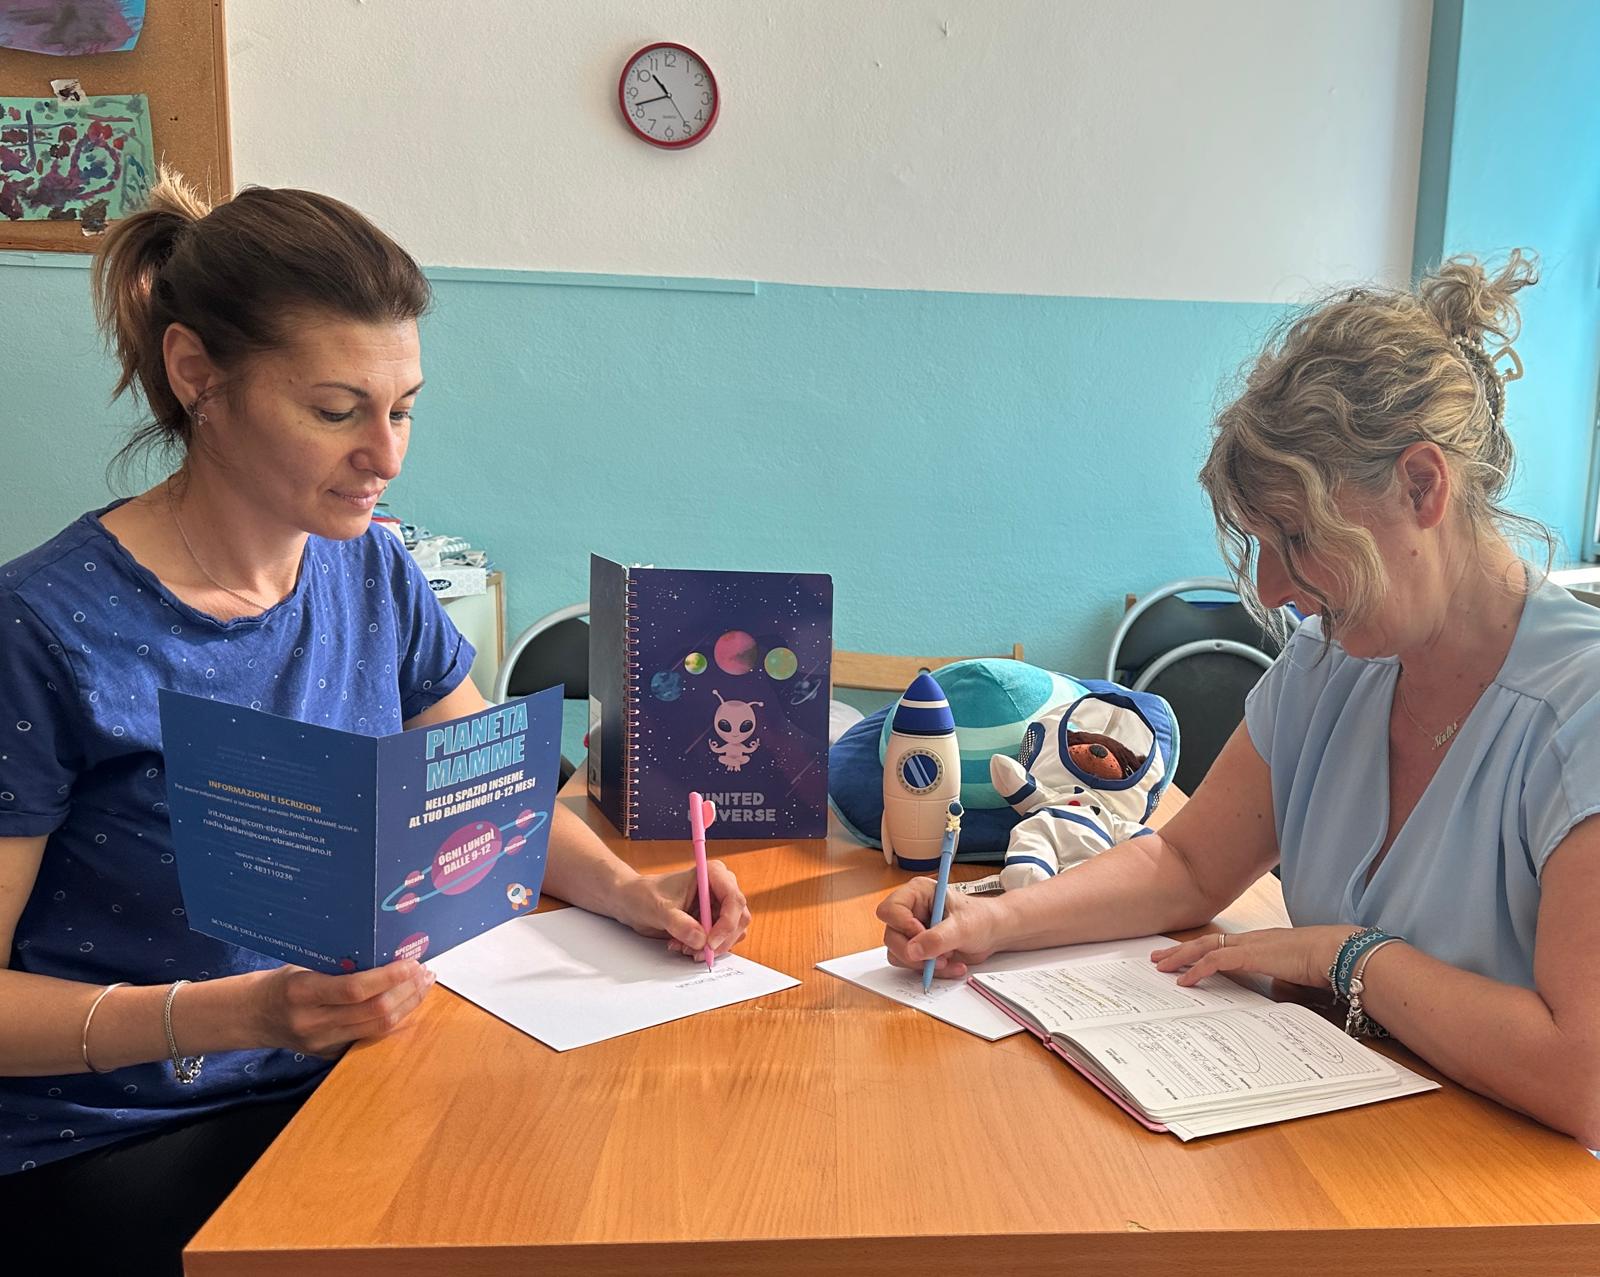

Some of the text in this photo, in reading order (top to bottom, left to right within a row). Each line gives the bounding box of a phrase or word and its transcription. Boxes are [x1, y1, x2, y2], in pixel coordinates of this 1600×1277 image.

[650, 58, 658, 71] 11
[664, 53, 676, 68] 12
[636, 69, 651, 82] 10
[694, 73, 704, 87] 2
[629, 87, 639, 99] 9
[700, 91, 710, 106] 3
[635, 104, 645, 118] 8
[694, 109, 703, 122] 4
[648, 119, 657, 131] 7
[664, 126, 674, 138] 6
[682, 121, 692, 134] 5
[426, 702, 529, 760] PIANETA
[426, 734, 526, 792] MAMME
[208, 779, 270, 801] INFORMAZIONI
[278, 796, 322, 814] ISCRIZIONI
[425, 769, 524, 811] NELLO SPAZIO INSIEME
[409, 777, 536, 828] AL TUO BAMBINO!! 0-12 MESI
[688, 808, 777, 822] VERSE
[438, 843, 462, 866] OGNI
[443, 856, 471, 876] DALLE
[471, 843, 492, 861] 9-12
[243, 861, 252, 870] 02
[240, 927, 263, 941] DELLA
